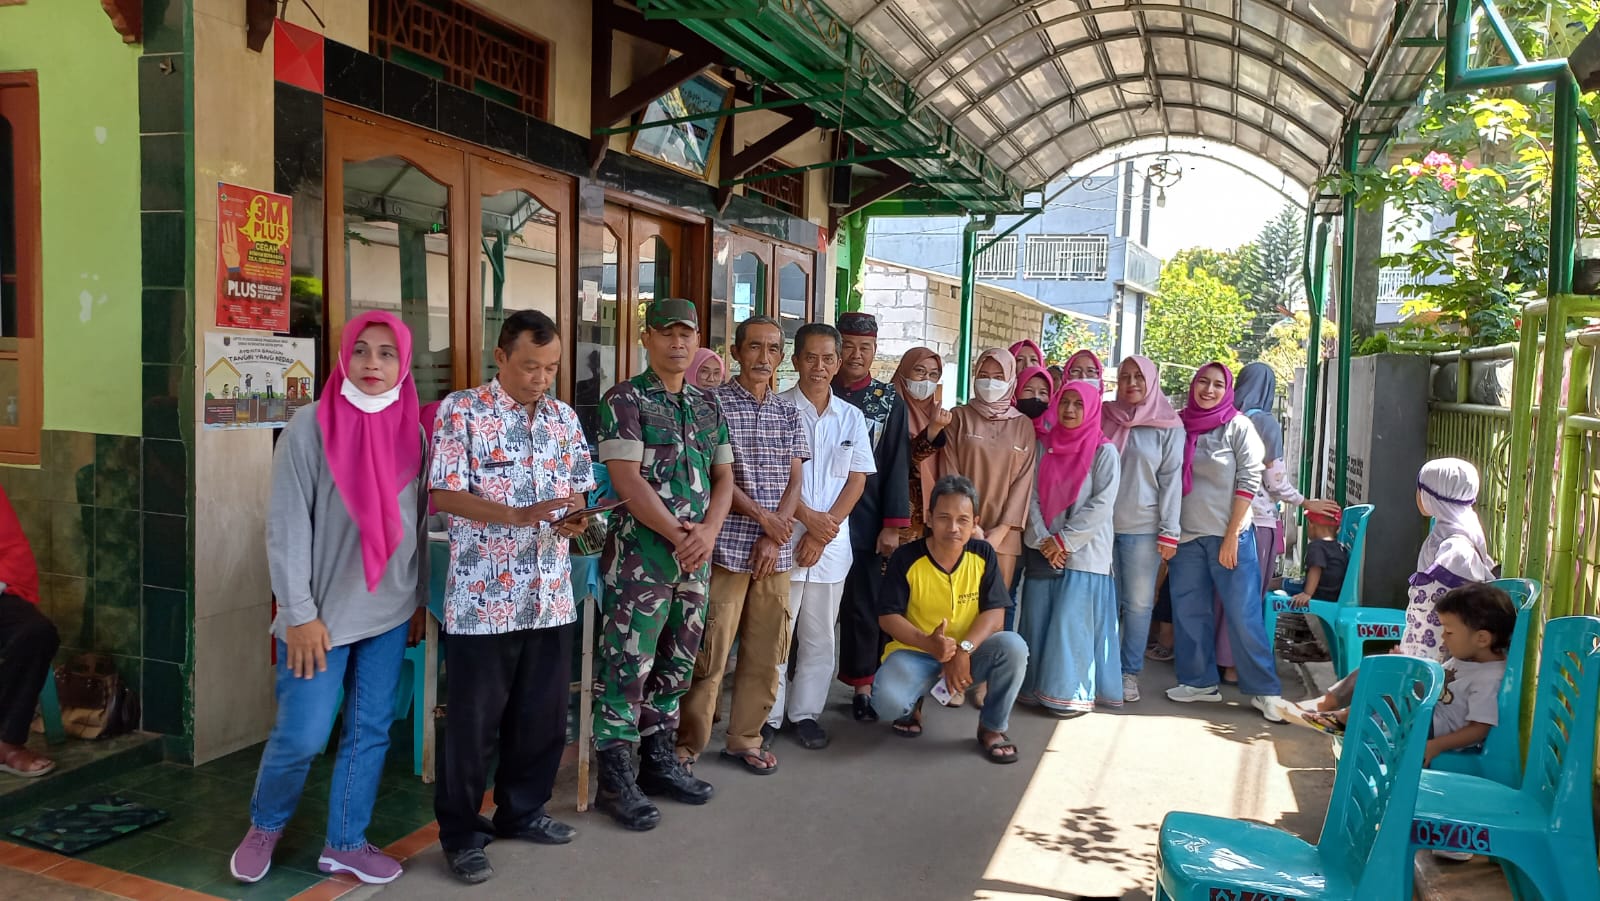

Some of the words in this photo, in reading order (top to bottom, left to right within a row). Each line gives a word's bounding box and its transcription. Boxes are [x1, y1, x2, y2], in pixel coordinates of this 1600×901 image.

[254, 197, 284, 226] 3M
[254, 222, 284, 242] PLUS
[227, 279, 257, 298] PLUS
